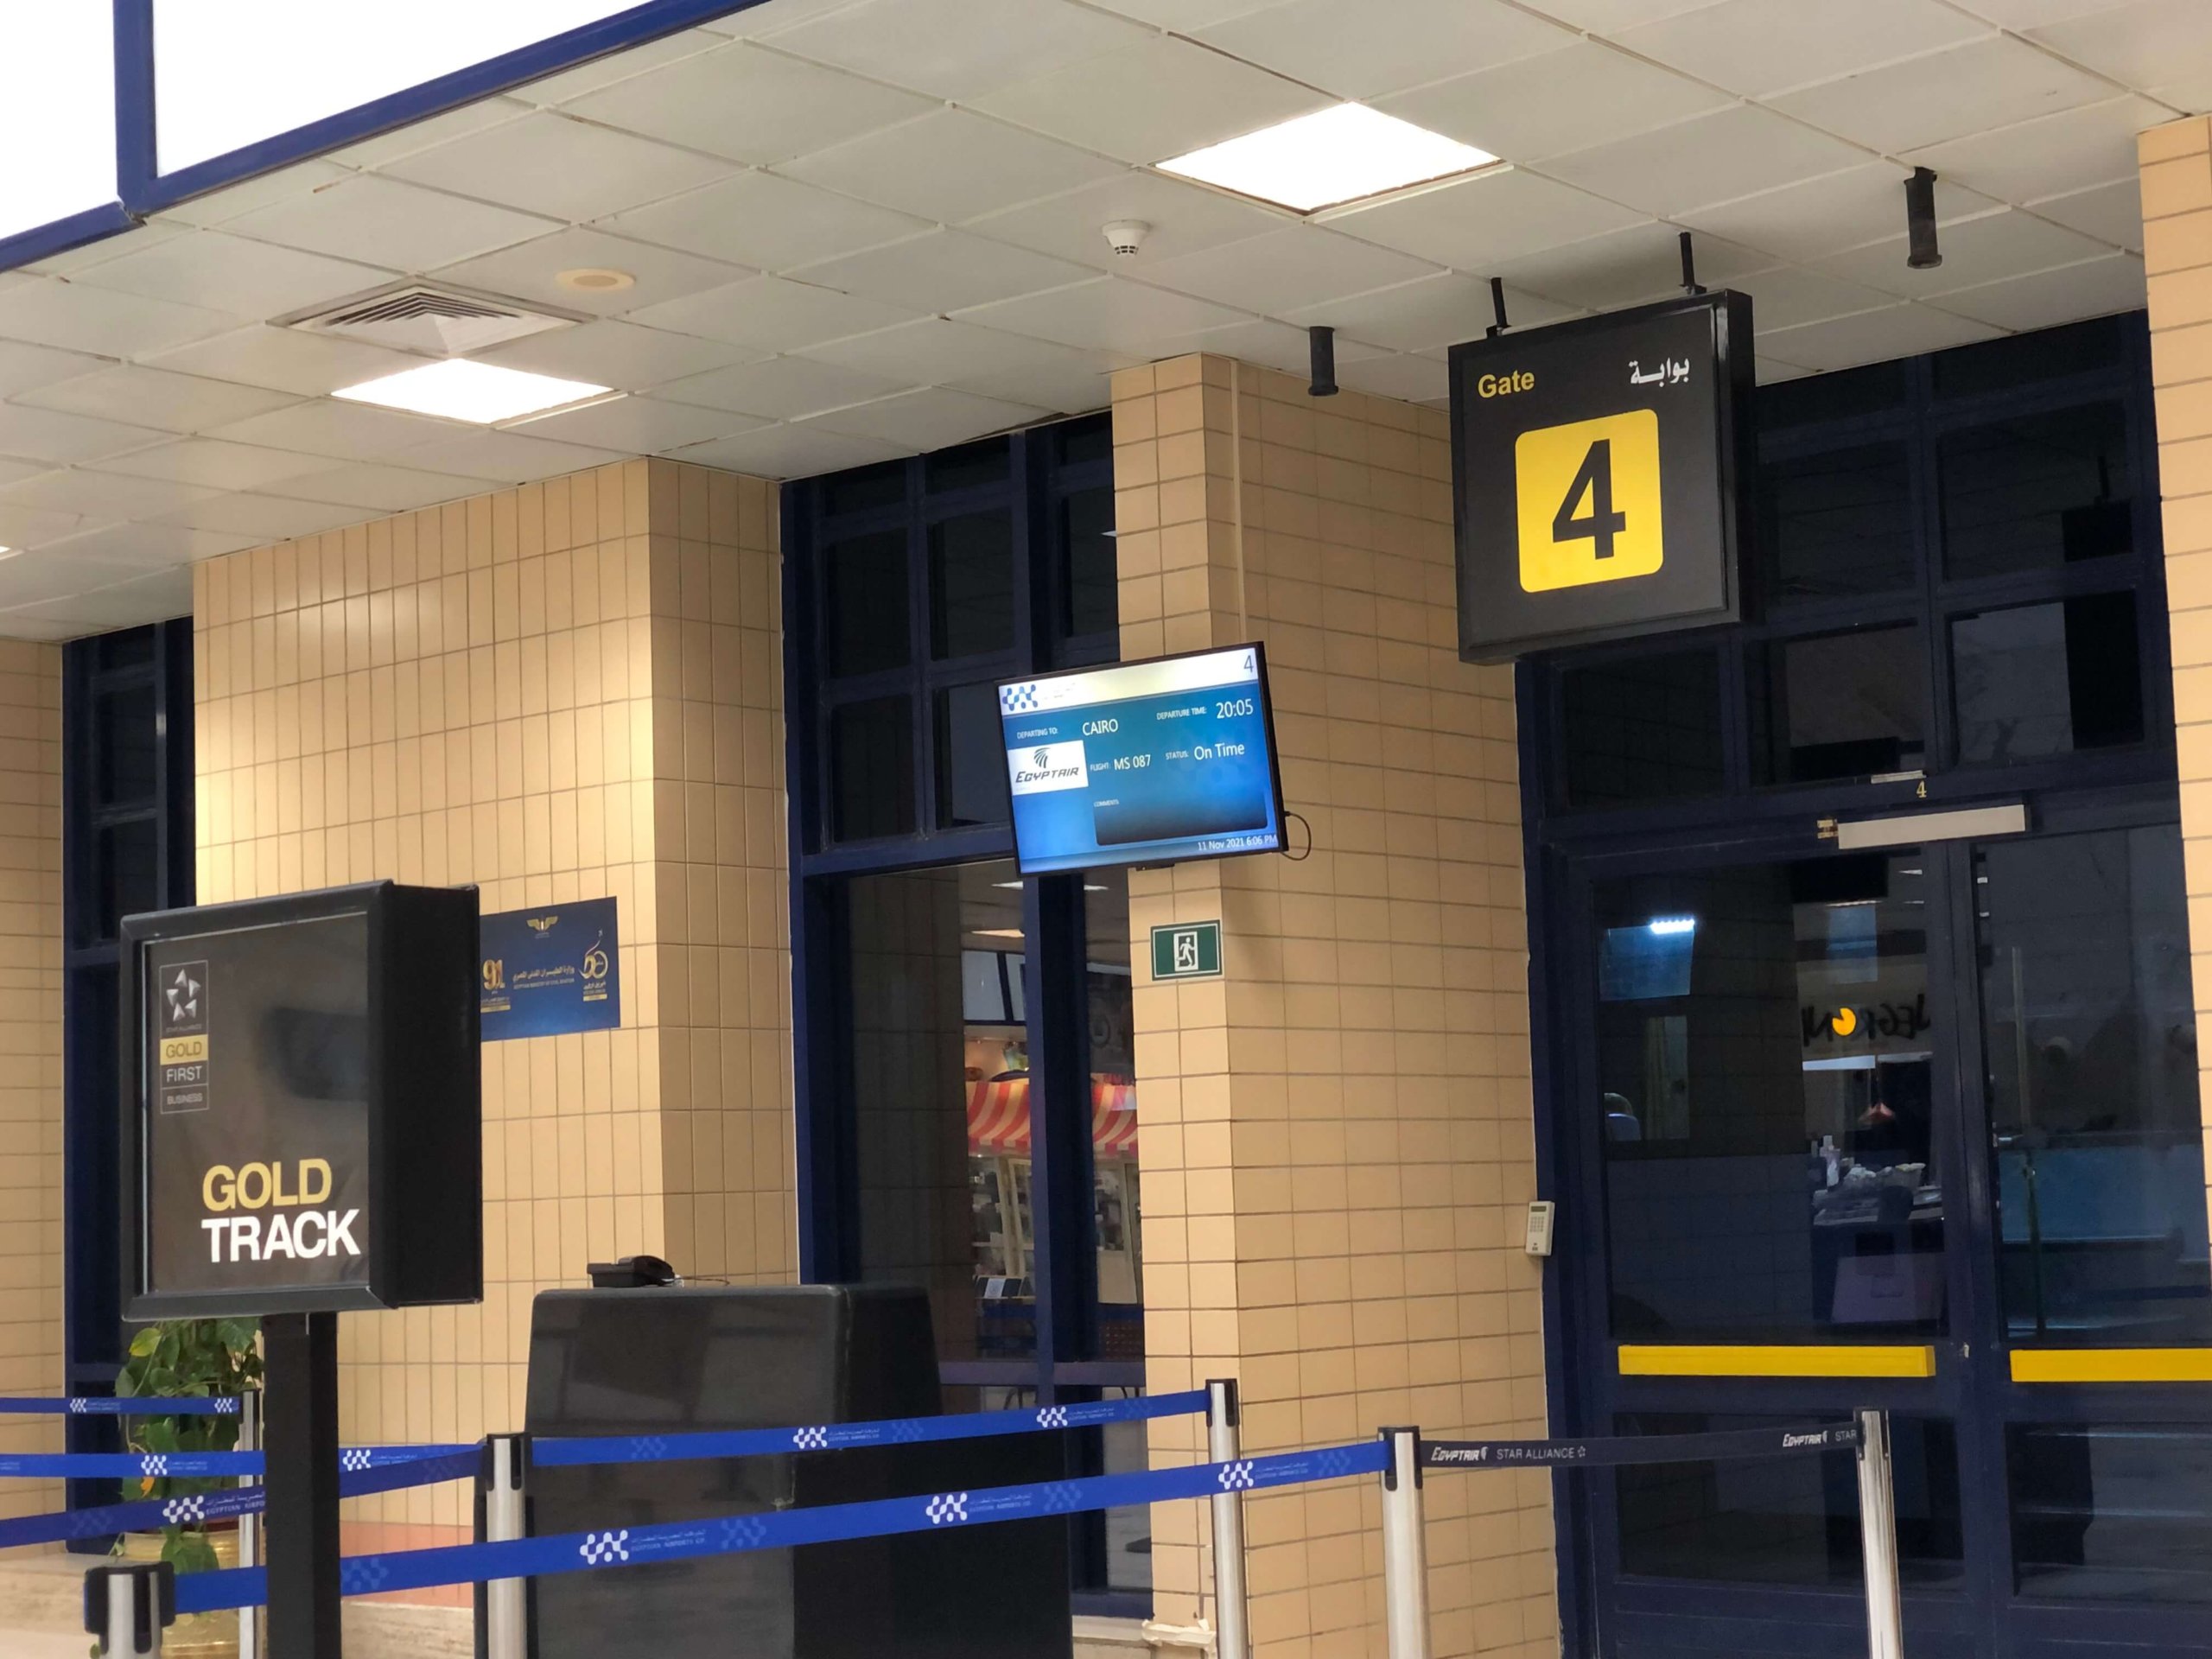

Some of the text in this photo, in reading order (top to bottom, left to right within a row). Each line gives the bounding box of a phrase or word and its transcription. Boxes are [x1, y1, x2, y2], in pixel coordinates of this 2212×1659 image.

[1628, 357, 1690, 388] بوابة
[1478, 370, 1535, 398] Gate
[1552, 438, 1626, 560] 4
[1243, 655, 1254, 672] 4
[1156, 709, 1191, 721] DEPARTURE
[1216, 698, 1254, 719] 20:05
[1017, 728, 1048, 740] DEPARTING
[1082, 719, 1119, 735] CAIRO
[1166, 750, 1189, 760] STATUS:
[1194, 742, 1245, 760] On Time
[1114, 754, 1151, 770] MS 087
[1015, 766, 1079, 783] EGYPTAIR
[1916, 780, 1927, 798] 4
[1198, 842, 1207, 851] 11
[1209, 840, 1224, 850] Nov
[1226, 837, 1244, 849] 2021
[1264, 834, 1277, 844] PM
[166, 1041, 202, 1058] GOLD
[167, 1065, 203, 1083] FIRST
[167, 1093, 203, 1105] BUSINESS
[202, 1158, 333, 1212] GOLD
[200, 1209, 361, 1263] TRACK
[1835, 1429, 1857, 1441] STAR
[1497, 1448, 1522, 1460] STAR
[1525, 1447, 1574, 1459] ALLIANCE
[245, 1500, 265, 1509] AIRPO
